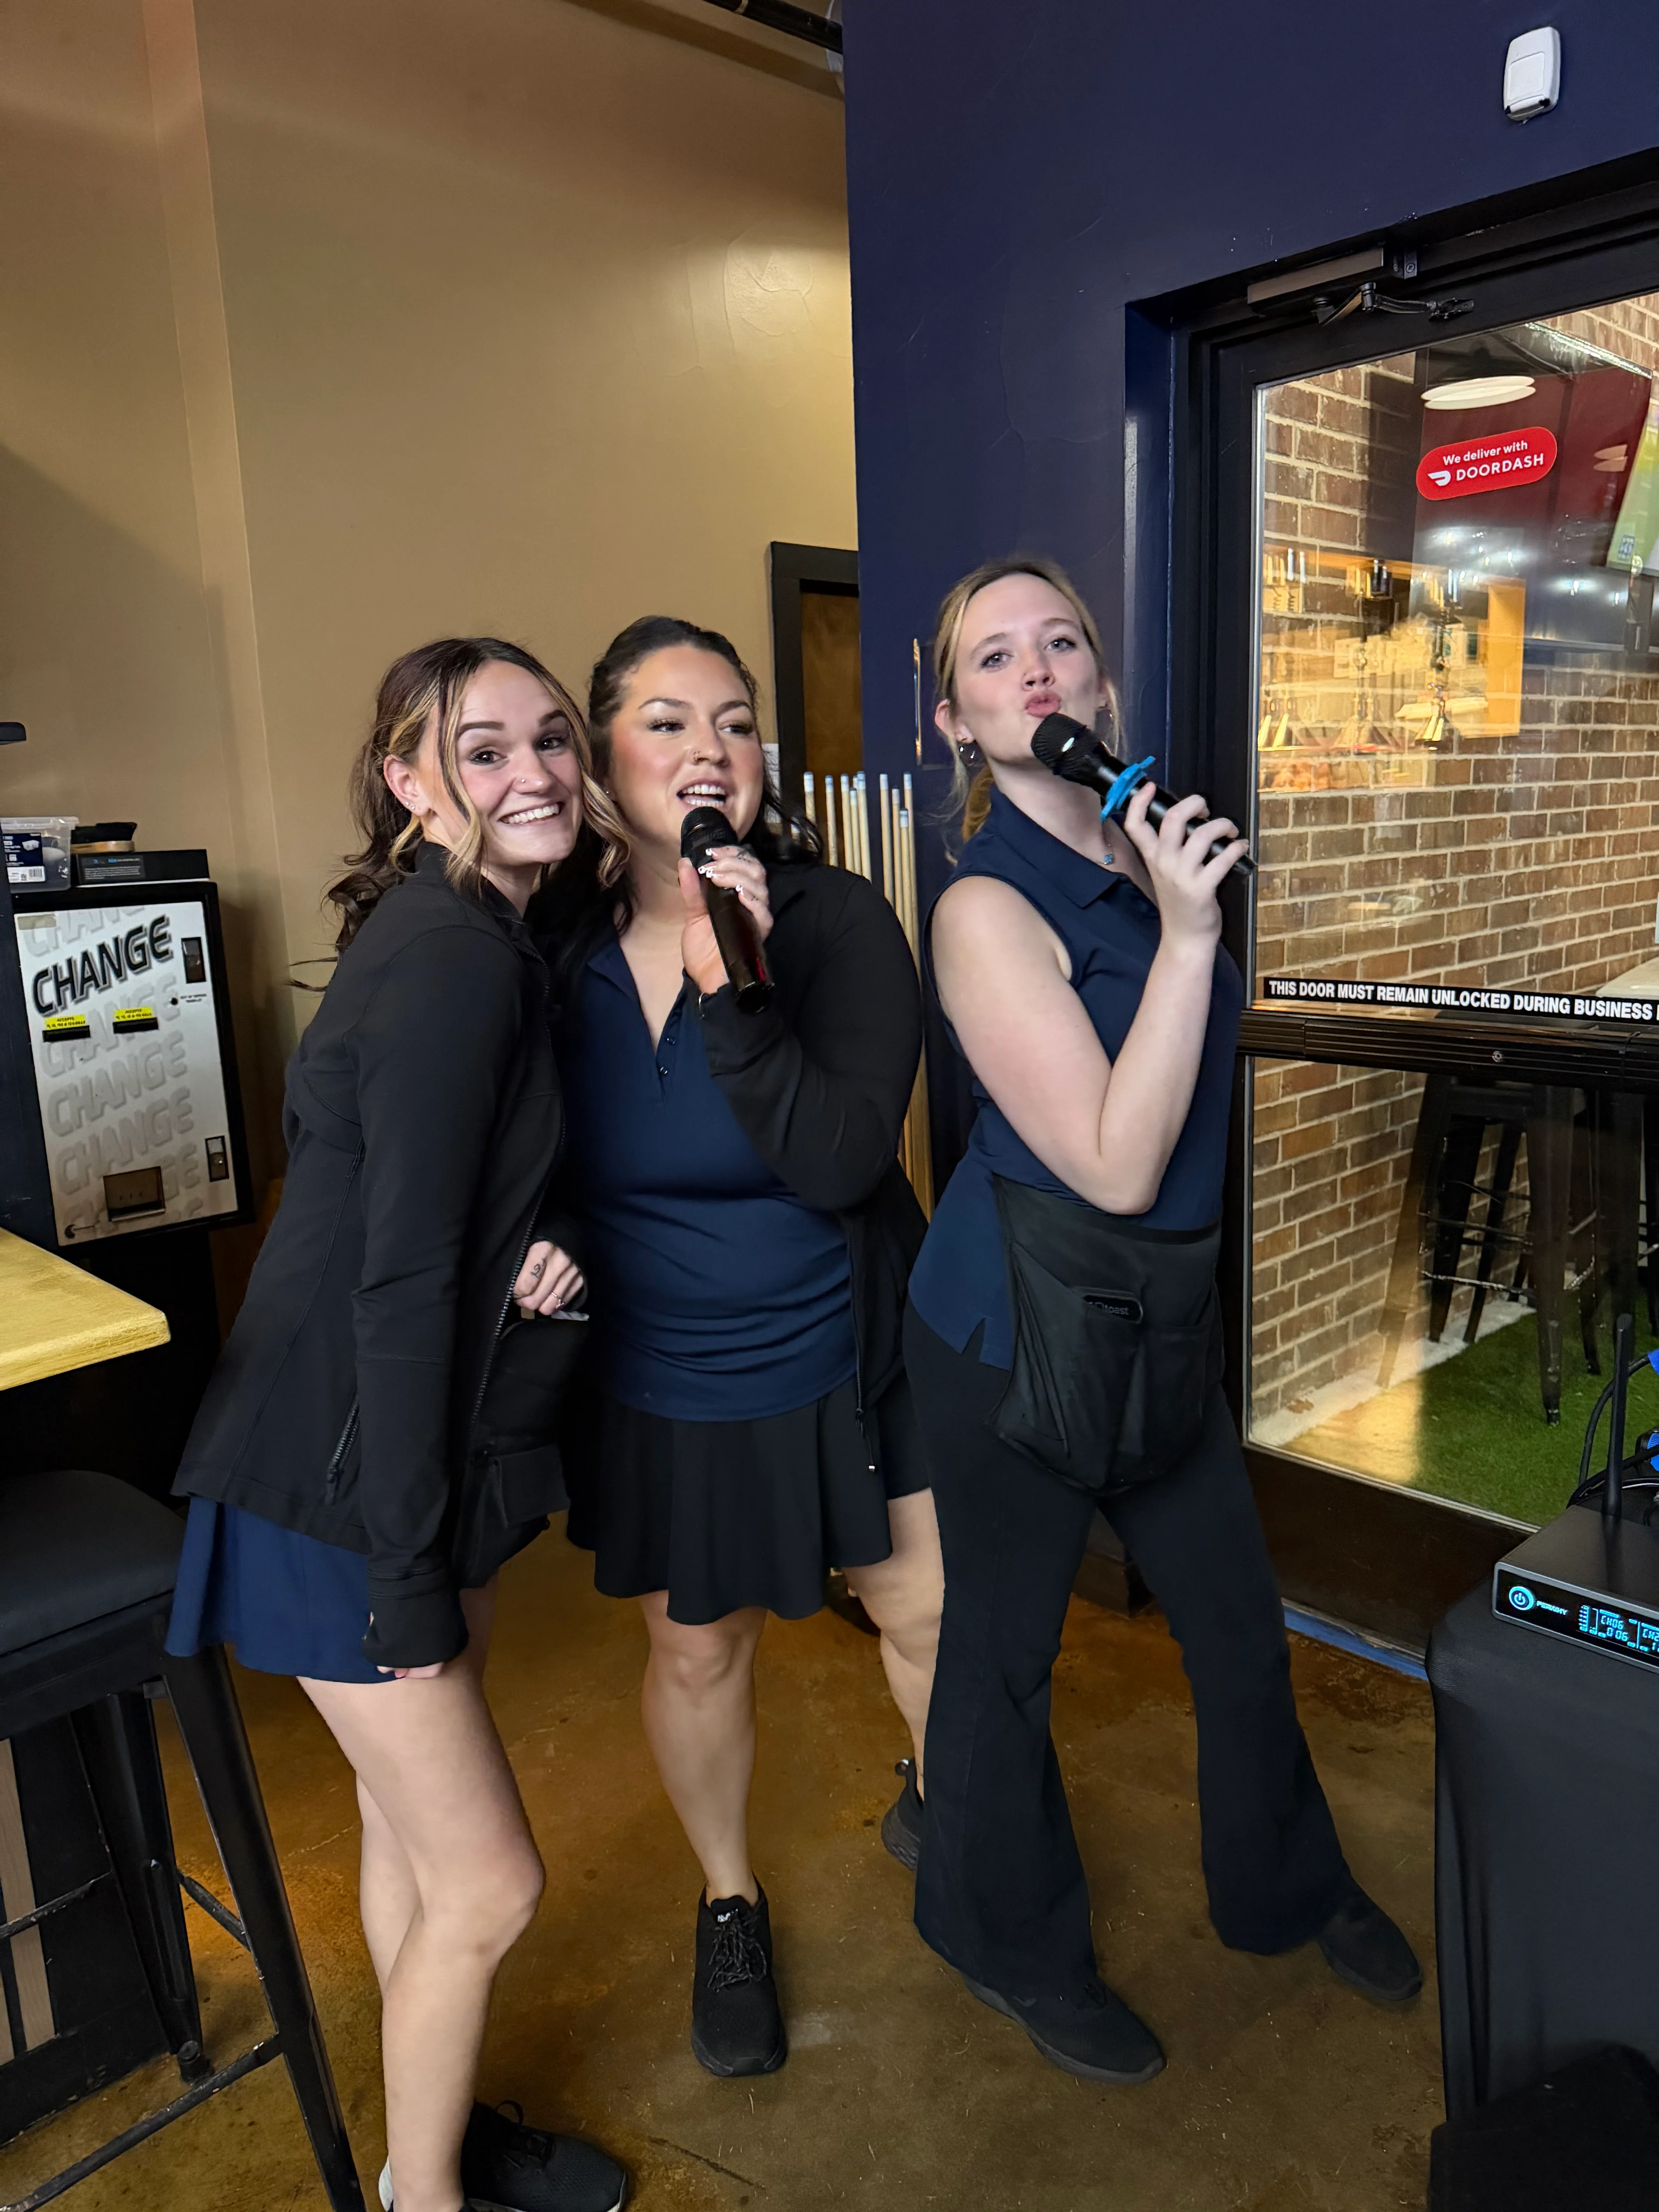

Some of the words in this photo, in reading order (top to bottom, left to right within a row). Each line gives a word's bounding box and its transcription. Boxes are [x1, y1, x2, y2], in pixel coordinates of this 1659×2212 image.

[1443, 455, 1461, 465] We
[1463, 447, 1501, 462] deliver
[1503, 440, 1528, 453] with
[1456, 453, 1544, 481] DOORDASH
[31, 914, 173, 1017] CHANGE
[1269, 980, 1297, 996] THIS
[1299, 982, 1335, 998] DOOR
[1338, 984, 1375, 1000] MUST
[1377, 986, 1429, 1004] REMAIN
[1432, 989, 1510, 1010] UNLOCKED
[1514, 994, 1570, 1014] DURING
[1574, 998, 1653, 1020] BUSINESS
[47, 1030, 188, 1137] CHANGE
[55, 1086, 194, 1195] CHANGE
